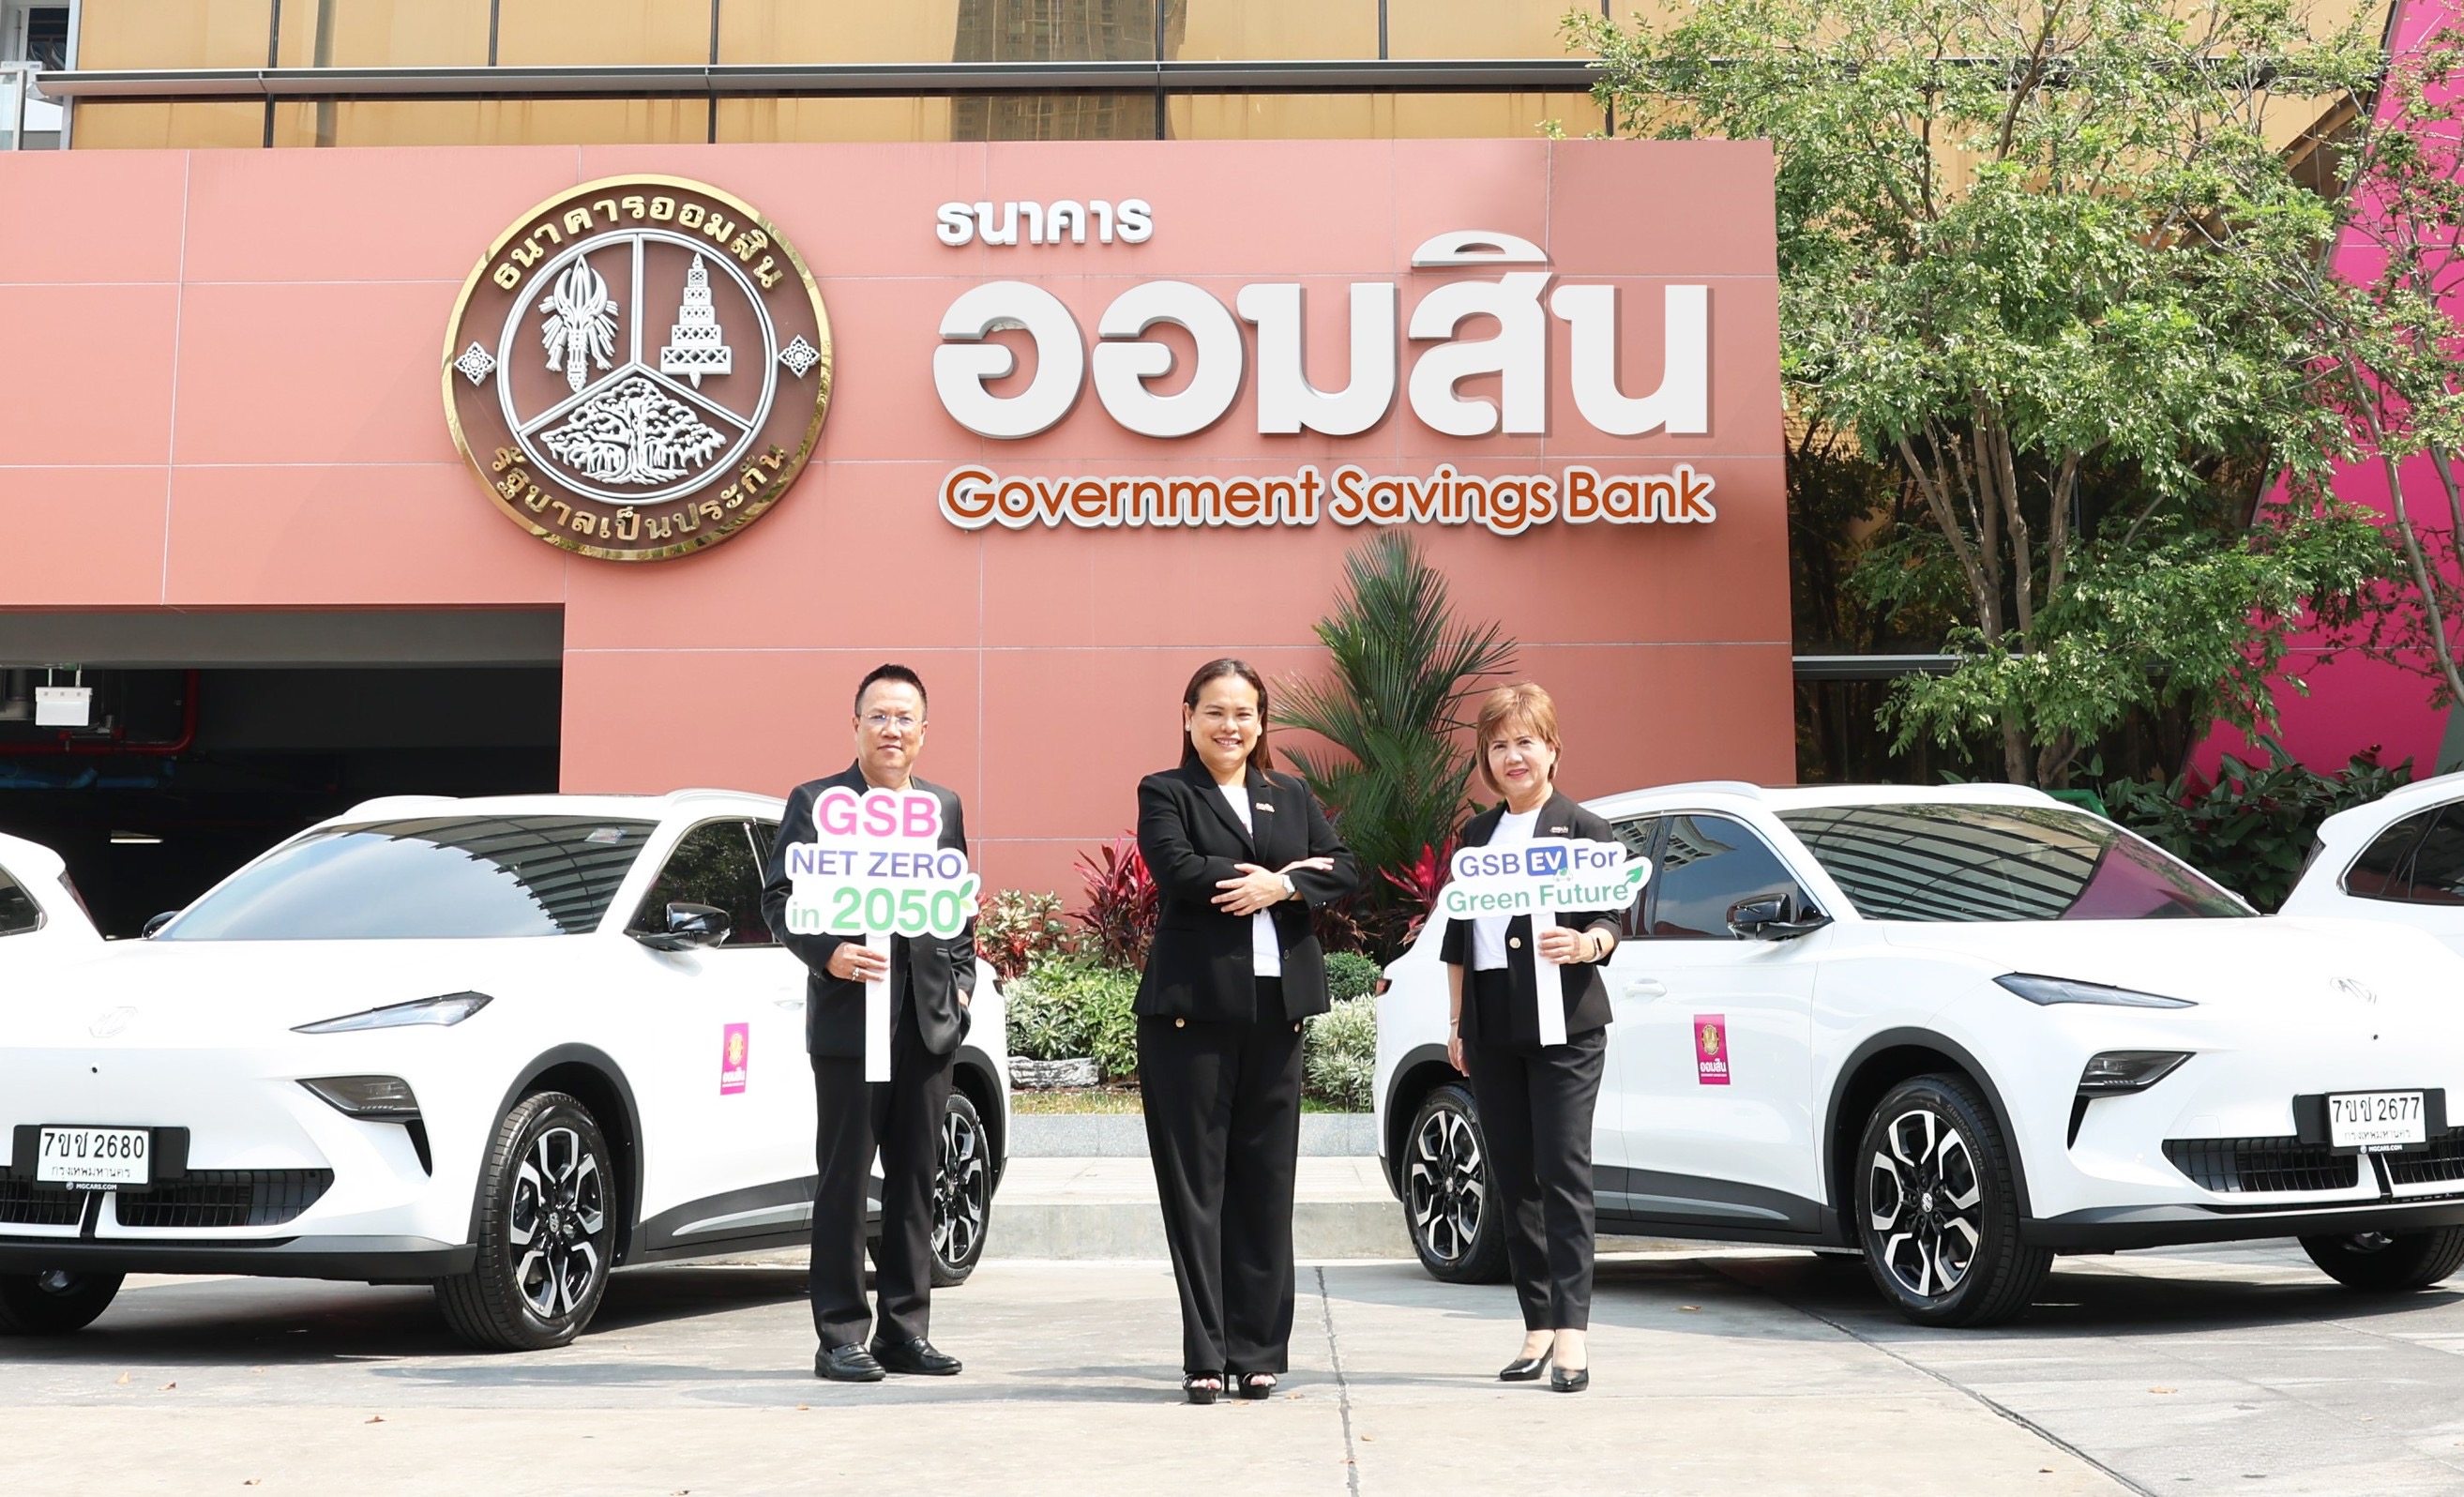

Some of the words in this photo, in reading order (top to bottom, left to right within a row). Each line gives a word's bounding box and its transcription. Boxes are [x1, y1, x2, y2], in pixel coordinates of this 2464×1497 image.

[492, 196, 785, 290] ธนาคารออมสิน
[935, 198, 1154, 247] ธนาคาร
[933, 231, 1709, 438] ออมสิน
[491, 444, 789, 541] รัฐบาลเป็นประกัน
[945, 469, 1320, 522] Government
[1338, 469, 1554, 531] Savings
[1569, 469, 1713, 522] Bank
[819, 793, 937, 838] GSB
[792, 849, 858, 876] NET
[868, 852, 961, 880] ZERO
[1459, 853, 1520, 878] GSB
[1531, 851, 1563, 871] EV
[1574, 848, 1618, 869] For
[792, 901, 820, 929] in
[831, 886, 961, 933] 2050
[1446, 889, 1531, 913] Green
[1539, 883, 1628, 907] Future
[2377, 1096, 2420, 1122] 2677
[94, 1134, 144, 1159] 2680
